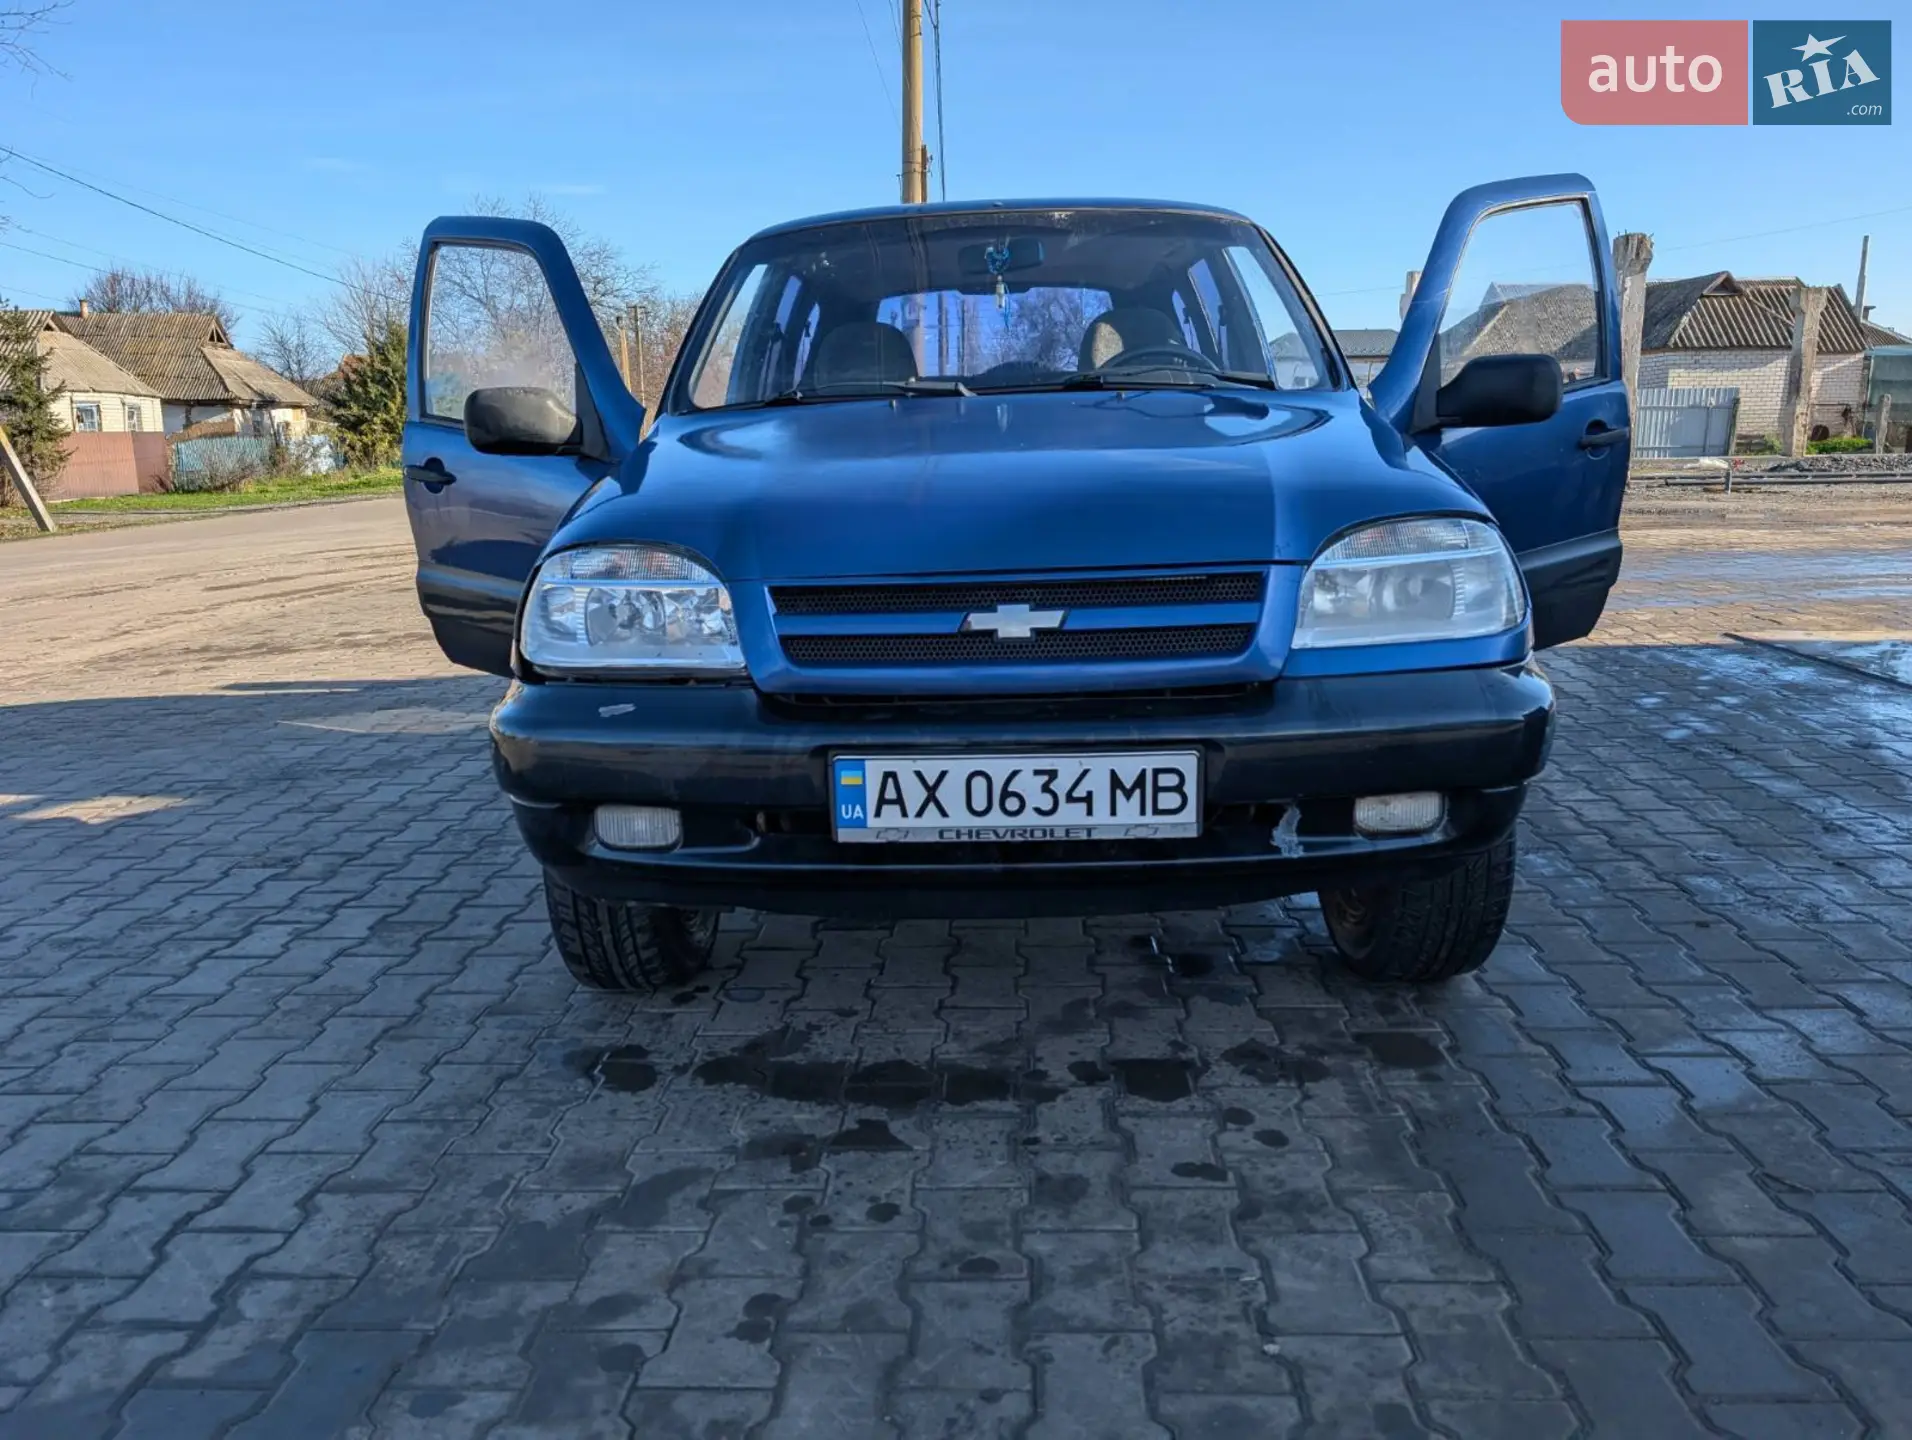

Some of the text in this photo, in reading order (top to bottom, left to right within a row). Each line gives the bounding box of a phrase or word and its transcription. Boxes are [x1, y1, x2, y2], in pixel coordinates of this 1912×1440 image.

[873, 767, 1188, 818] AX 0634 MB
[841, 804, 864, 819] UA
[938, 826, 1098, 841] CHEVROLET
